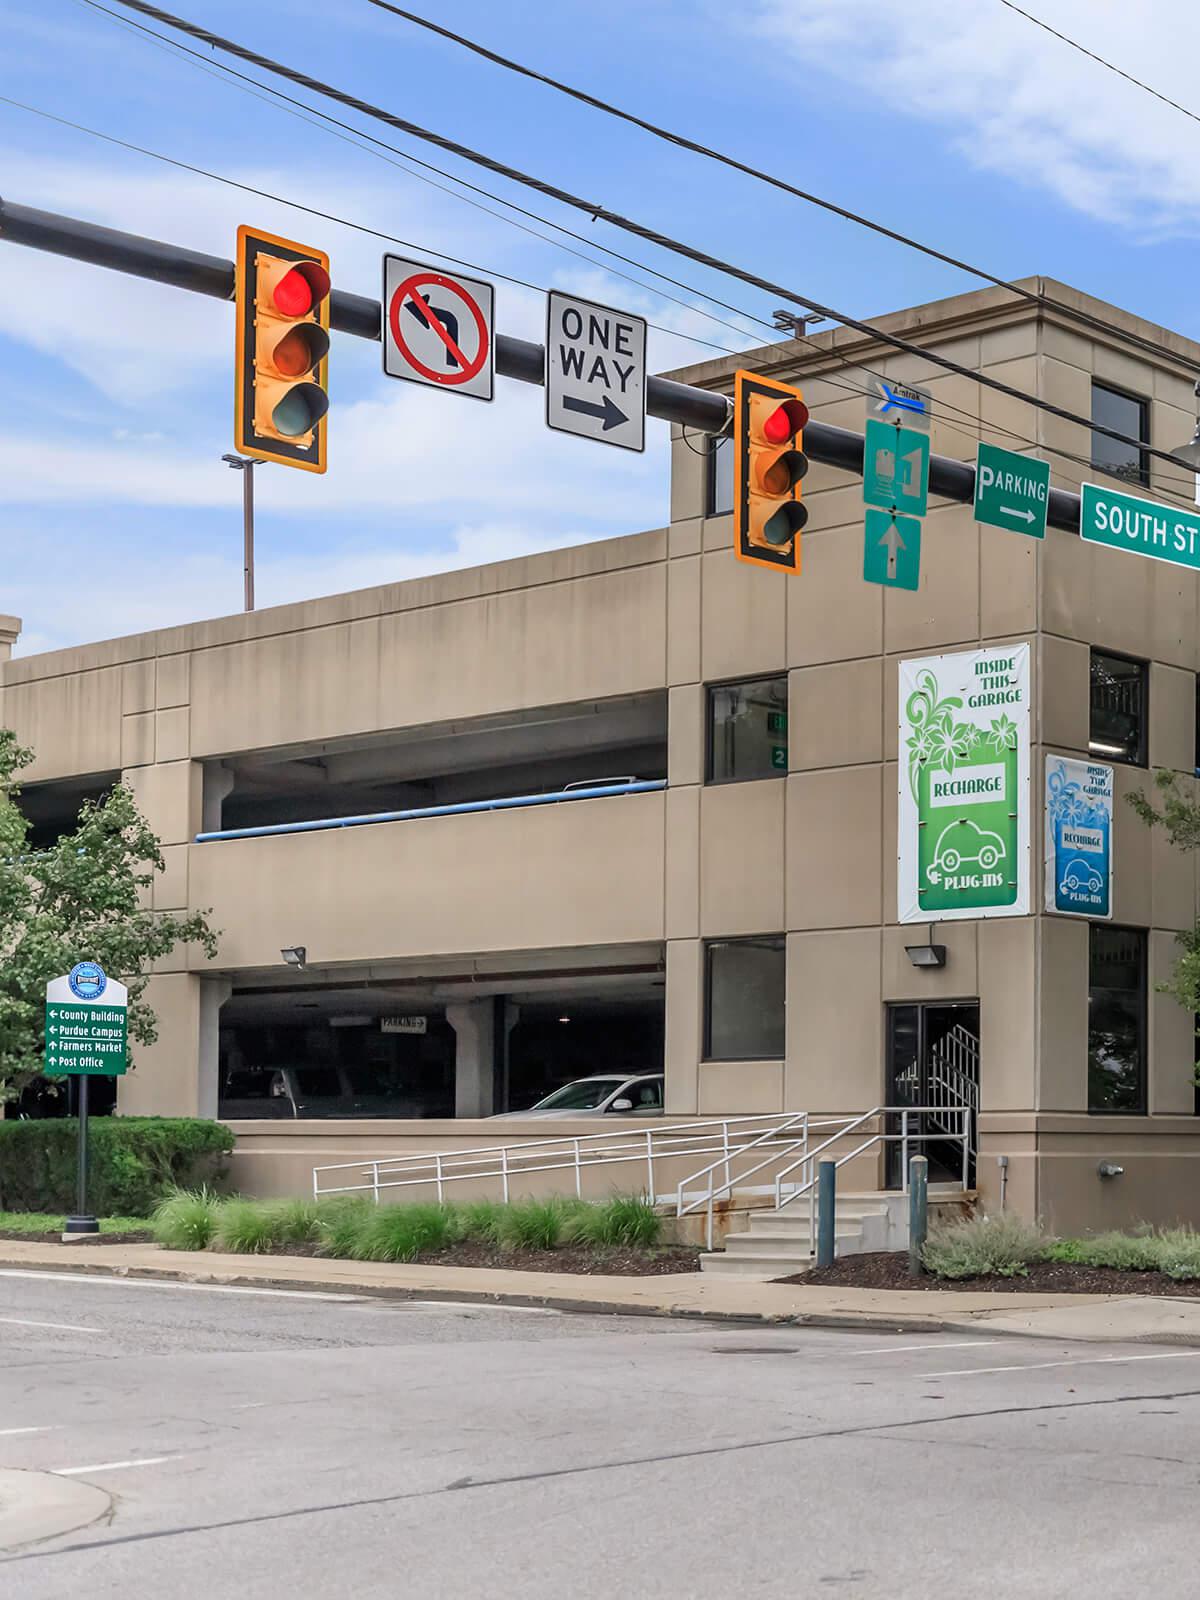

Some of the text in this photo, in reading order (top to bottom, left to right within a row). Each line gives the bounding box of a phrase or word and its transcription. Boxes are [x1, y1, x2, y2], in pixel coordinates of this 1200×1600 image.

[562, 308, 633, 357] ONE
[560, 344, 635, 393] WAY
[978, 466, 1046, 502] PARKING
[1094, 501, 1199, 554] SOUTH ST
[974, 657, 1016, 675] INSIDE
[980, 675, 1011, 690] THIS
[968, 688, 1023, 709] GARAGE
[775, 750, 785, 764] 2
[933, 776, 1002, 798] RECHARGE
[1063, 832, 1101, 847] RECHARGE
[943, 872, 1004, 891] PLUG-INS
[60, 1010, 124, 1024] County Building
[59, 1025, 123, 1039] Purdue Campus
[59, 1041, 122, 1053] Farmers Market
[59, 1056, 104, 1067] Post Office
